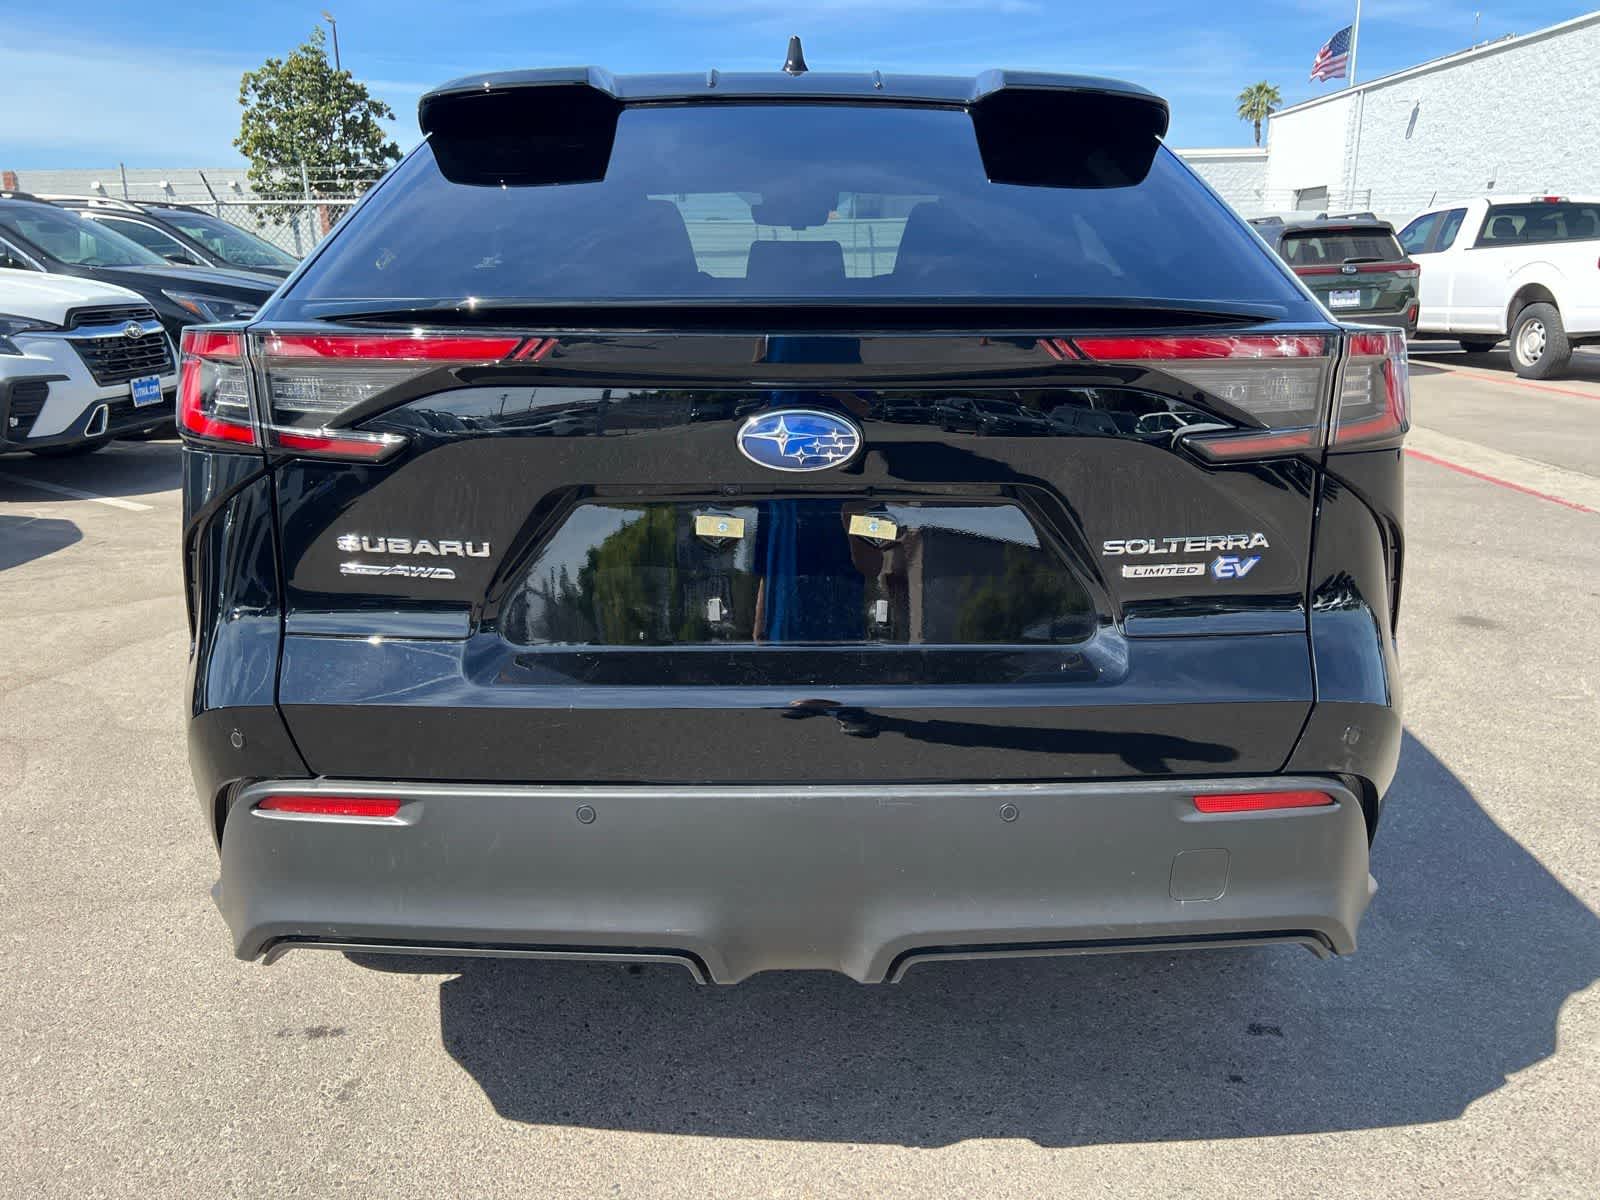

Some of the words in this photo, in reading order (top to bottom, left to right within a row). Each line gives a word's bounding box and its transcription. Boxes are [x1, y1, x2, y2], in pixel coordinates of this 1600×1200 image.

[336, 534, 490, 558] SUBARU
[1102, 532, 1270, 556] SOLTERRA
[382, 564, 457, 580] AWD
[1131, 565, 1200, 577] LIMITED
[1210, 555, 1261, 580] EV
